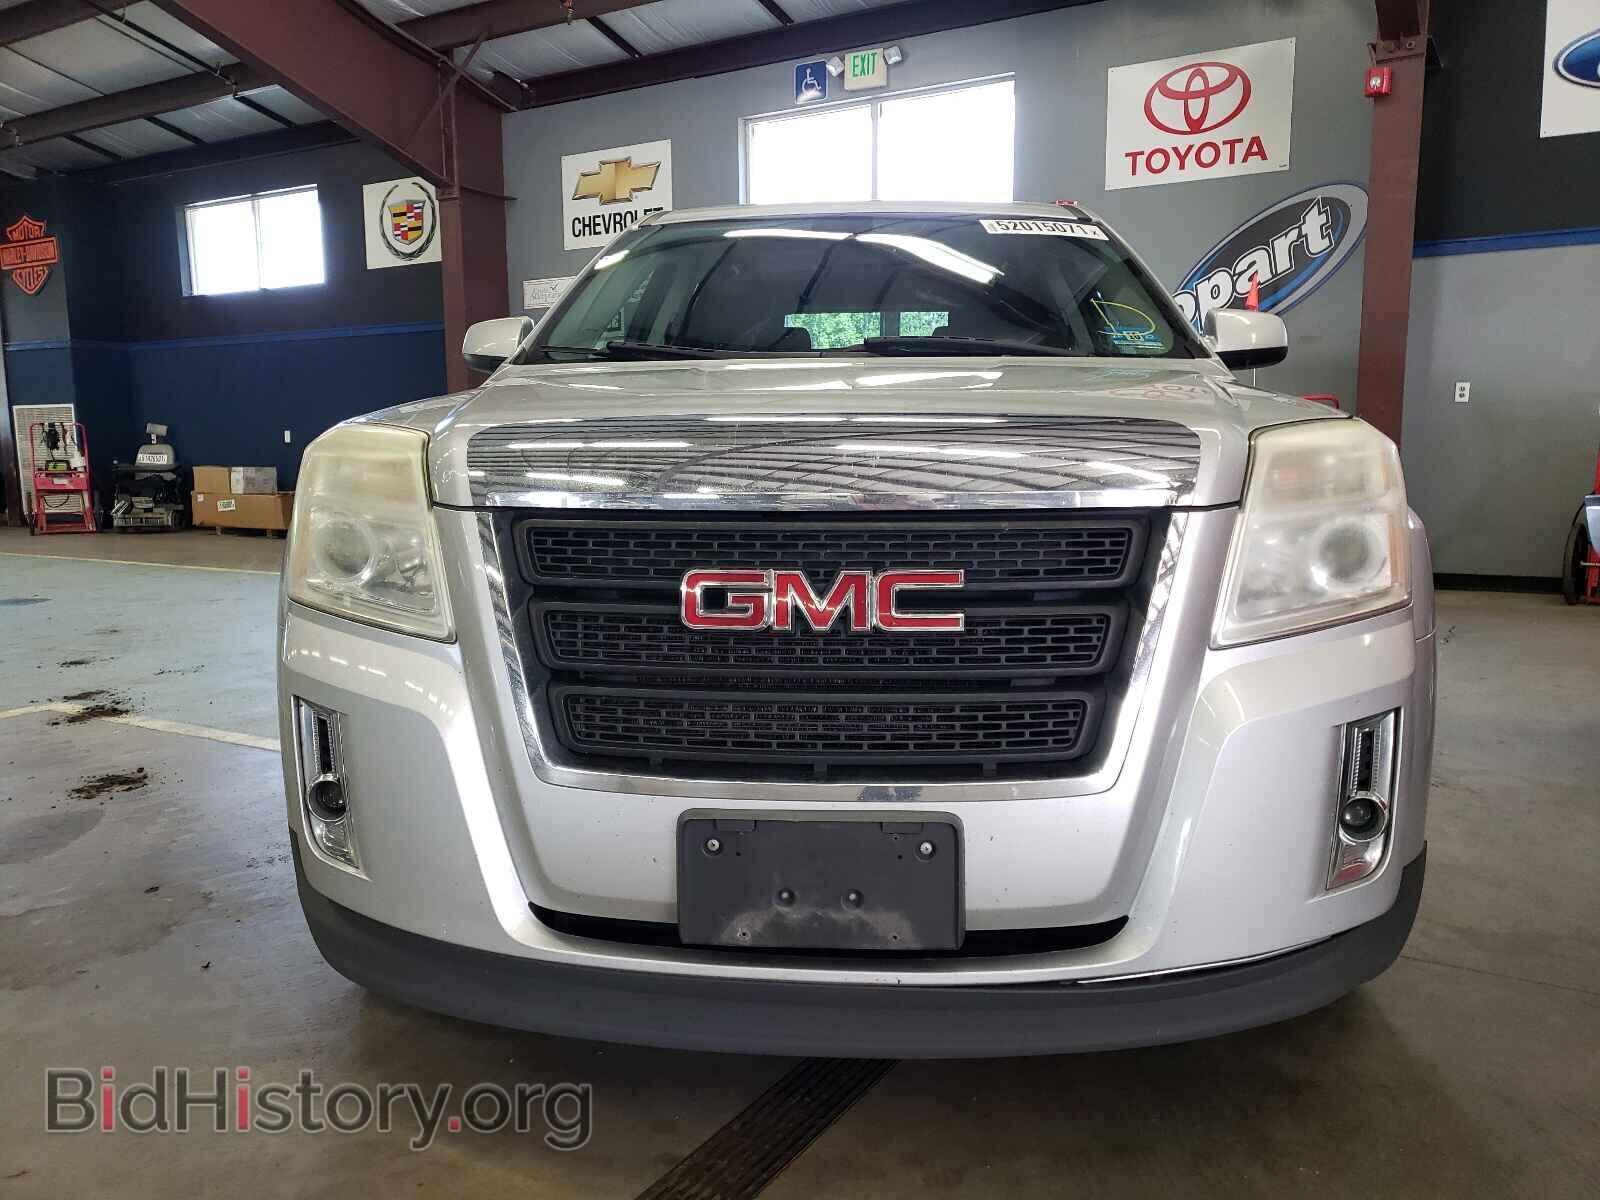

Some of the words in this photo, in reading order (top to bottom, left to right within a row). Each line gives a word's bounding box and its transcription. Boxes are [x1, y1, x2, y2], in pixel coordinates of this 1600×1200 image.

[852, 52, 877, 77] EXIT
[1125, 135, 1268, 176] TOYOTA
[571, 206, 664, 238] CHEVRO
[996, 220, 1088, 235] 52015071
[1172, 195, 1335, 334] opart
[681, 569, 964, 632] GMC
